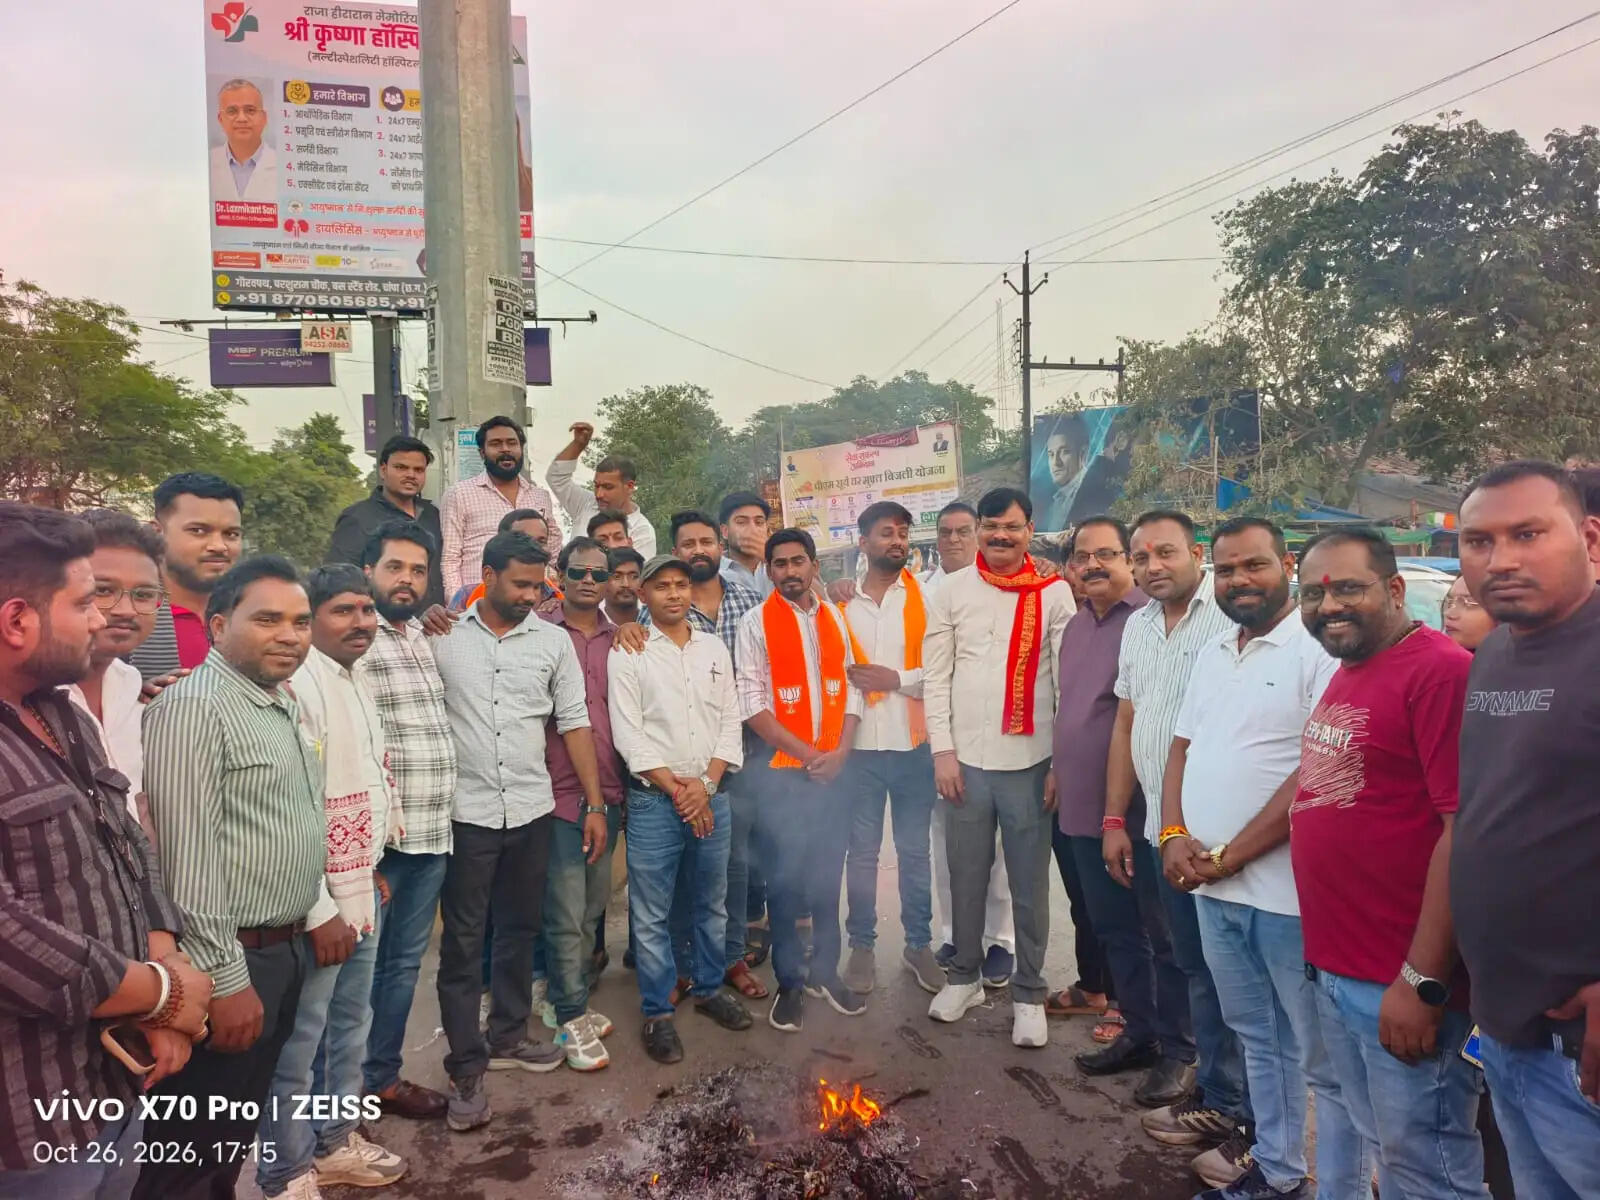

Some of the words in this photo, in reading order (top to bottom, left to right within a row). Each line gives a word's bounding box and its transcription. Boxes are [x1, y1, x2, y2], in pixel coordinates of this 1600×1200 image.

[304, 6, 328, 17] राजा
[376, 9, 419, 24] मेमोरिय
[284, 16, 310, 42] श्री
[313, 23, 367, 52] कृष्णा
[370, 23, 419, 50] हॉस्पि
[312, 89, 336, 102] हमारे
[338, 89, 367, 104] विभाग
[331, 109, 354, 122] विभाग
[284, 125, 293, 136] 2.
[285, 143, 294, 153] 3.
[286, 162, 295, 172] 4.
[287, 178, 296, 189] 5.
[216, 203, 226, 213] Dr.
[236, 293, 267, 304] +91
[502, 300, 522, 315] DC
[502, 330, 522, 347] BC
[884, 466, 913, 481] बिजली
[916, 465, 945, 478] योजना
